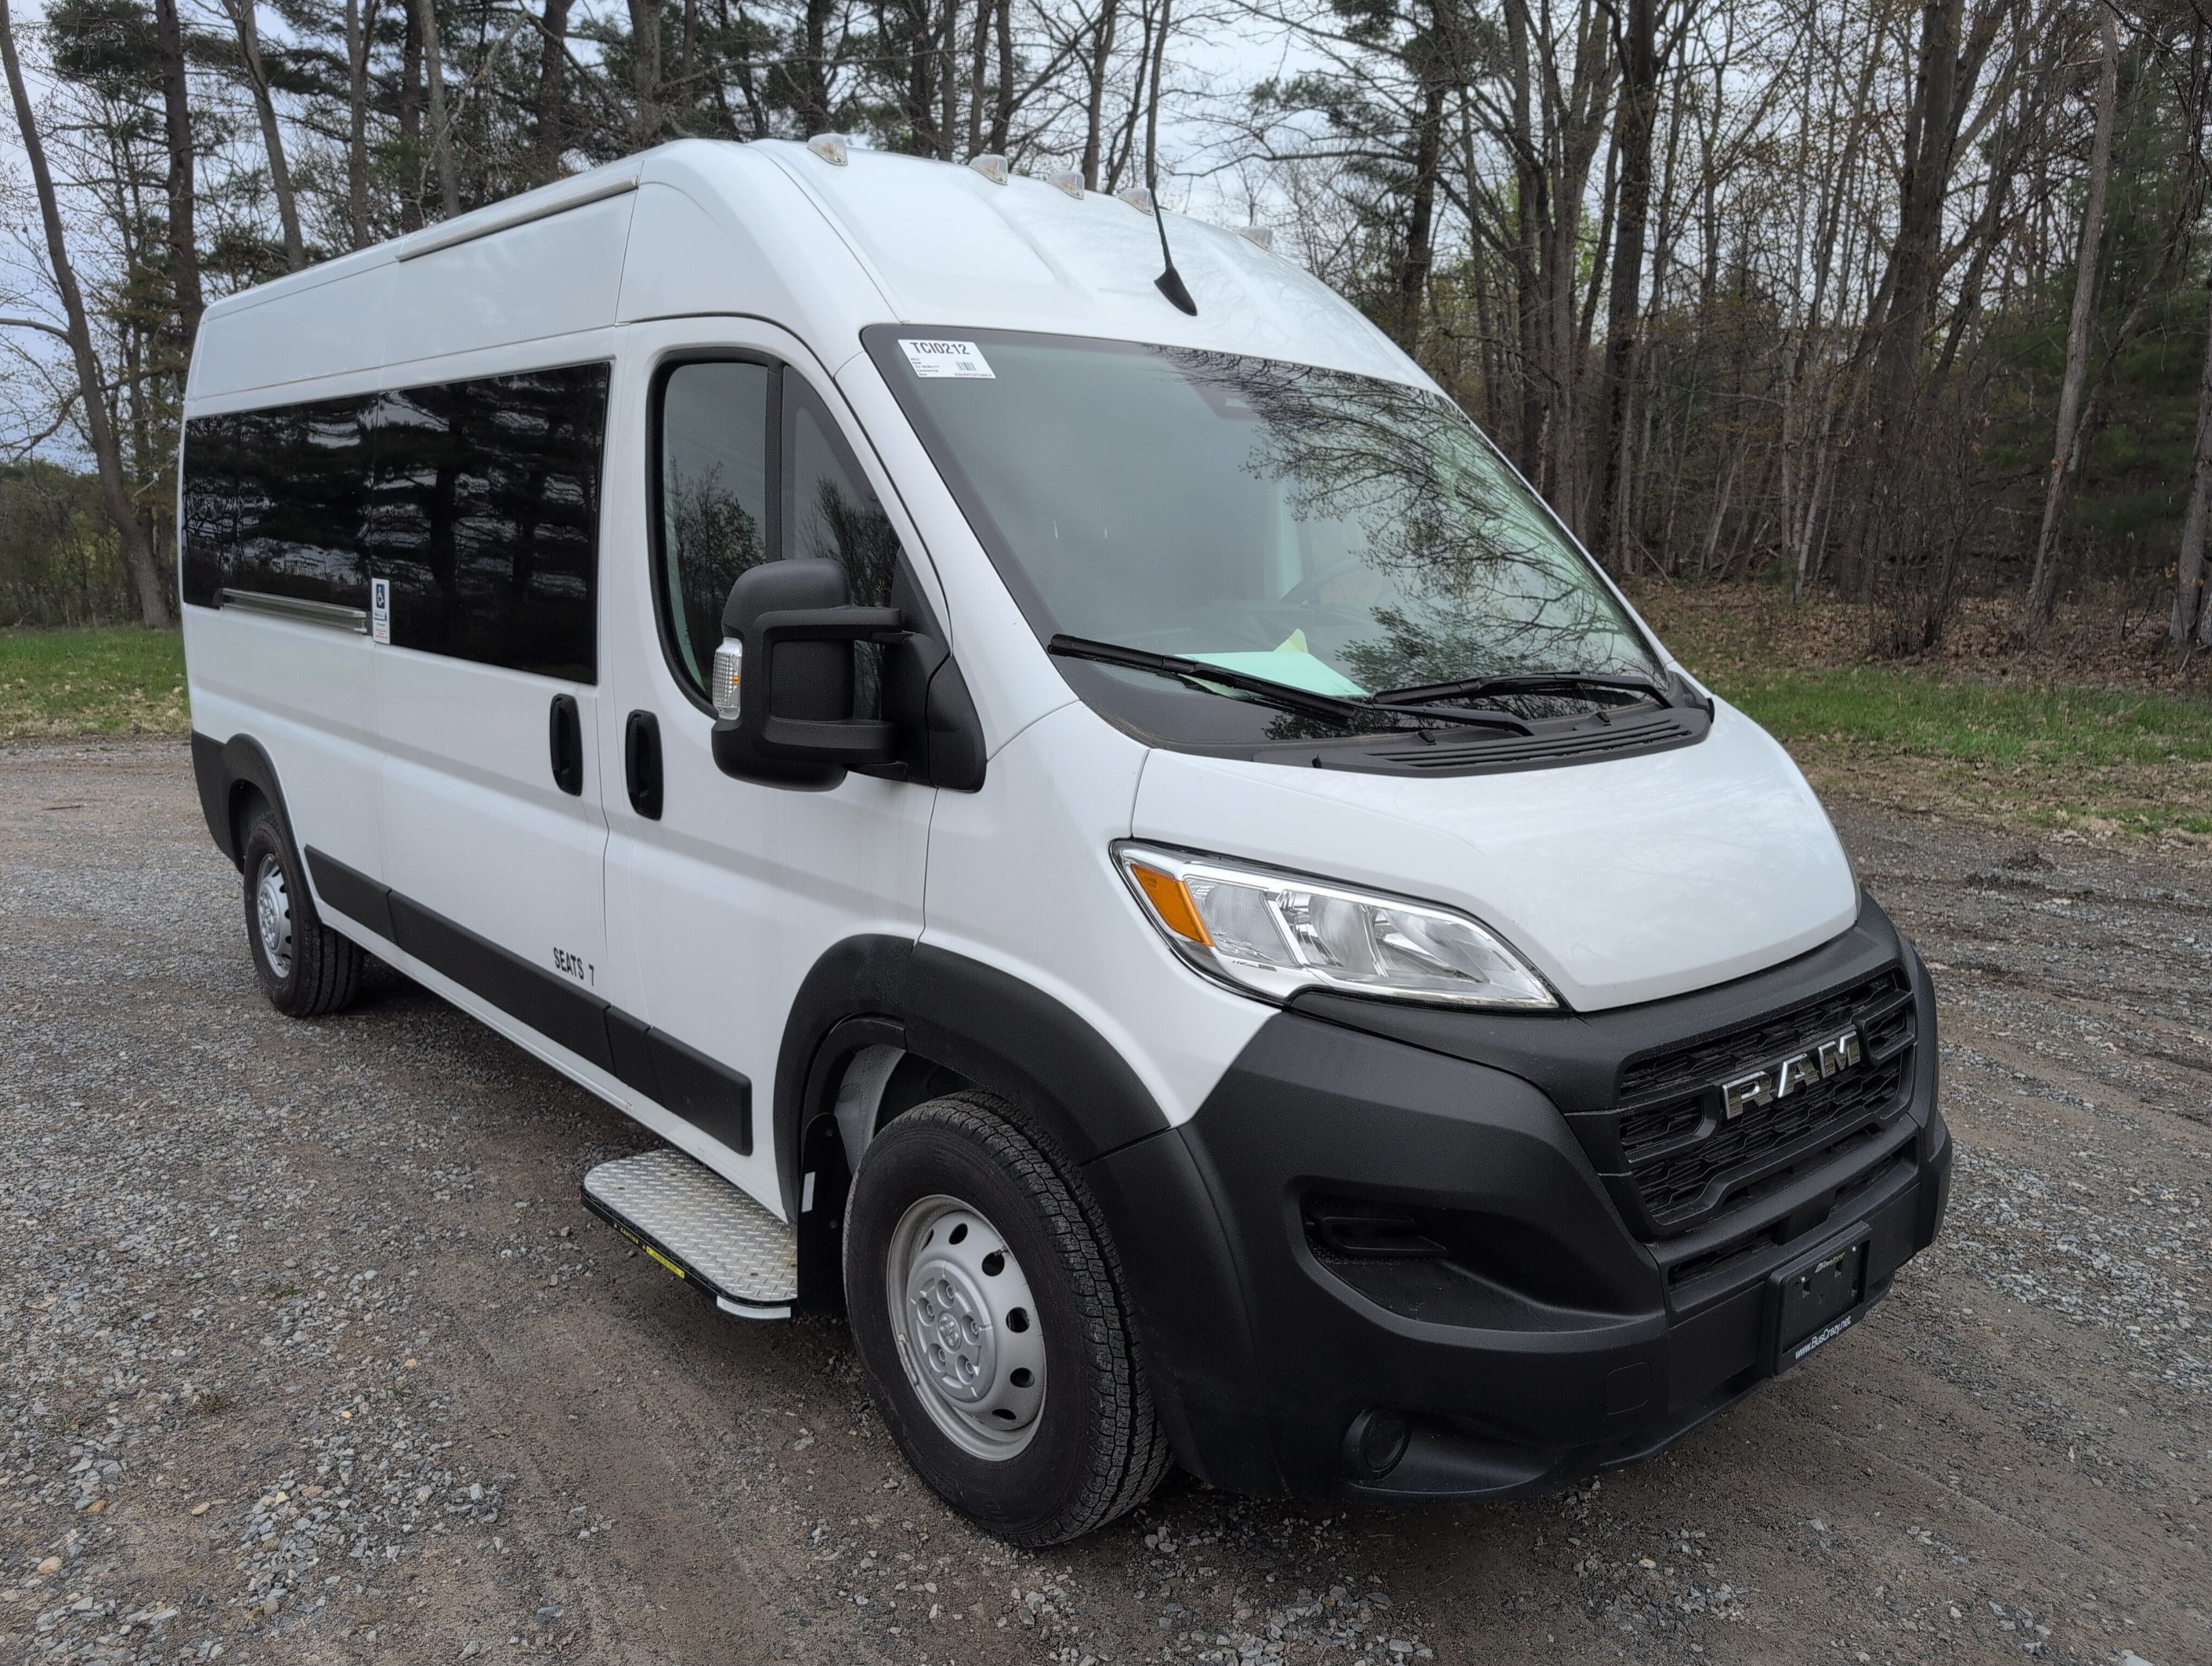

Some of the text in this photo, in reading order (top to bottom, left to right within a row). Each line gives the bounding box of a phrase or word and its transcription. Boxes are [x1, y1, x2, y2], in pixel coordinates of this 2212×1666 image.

[910, 342, 970, 355] TCI0212
[554, 947, 594, 986] SEATS 7
[1722, 1030, 1861, 1119] RAM
[1795, 1315, 1851, 1360] www.BusCrazy.net
